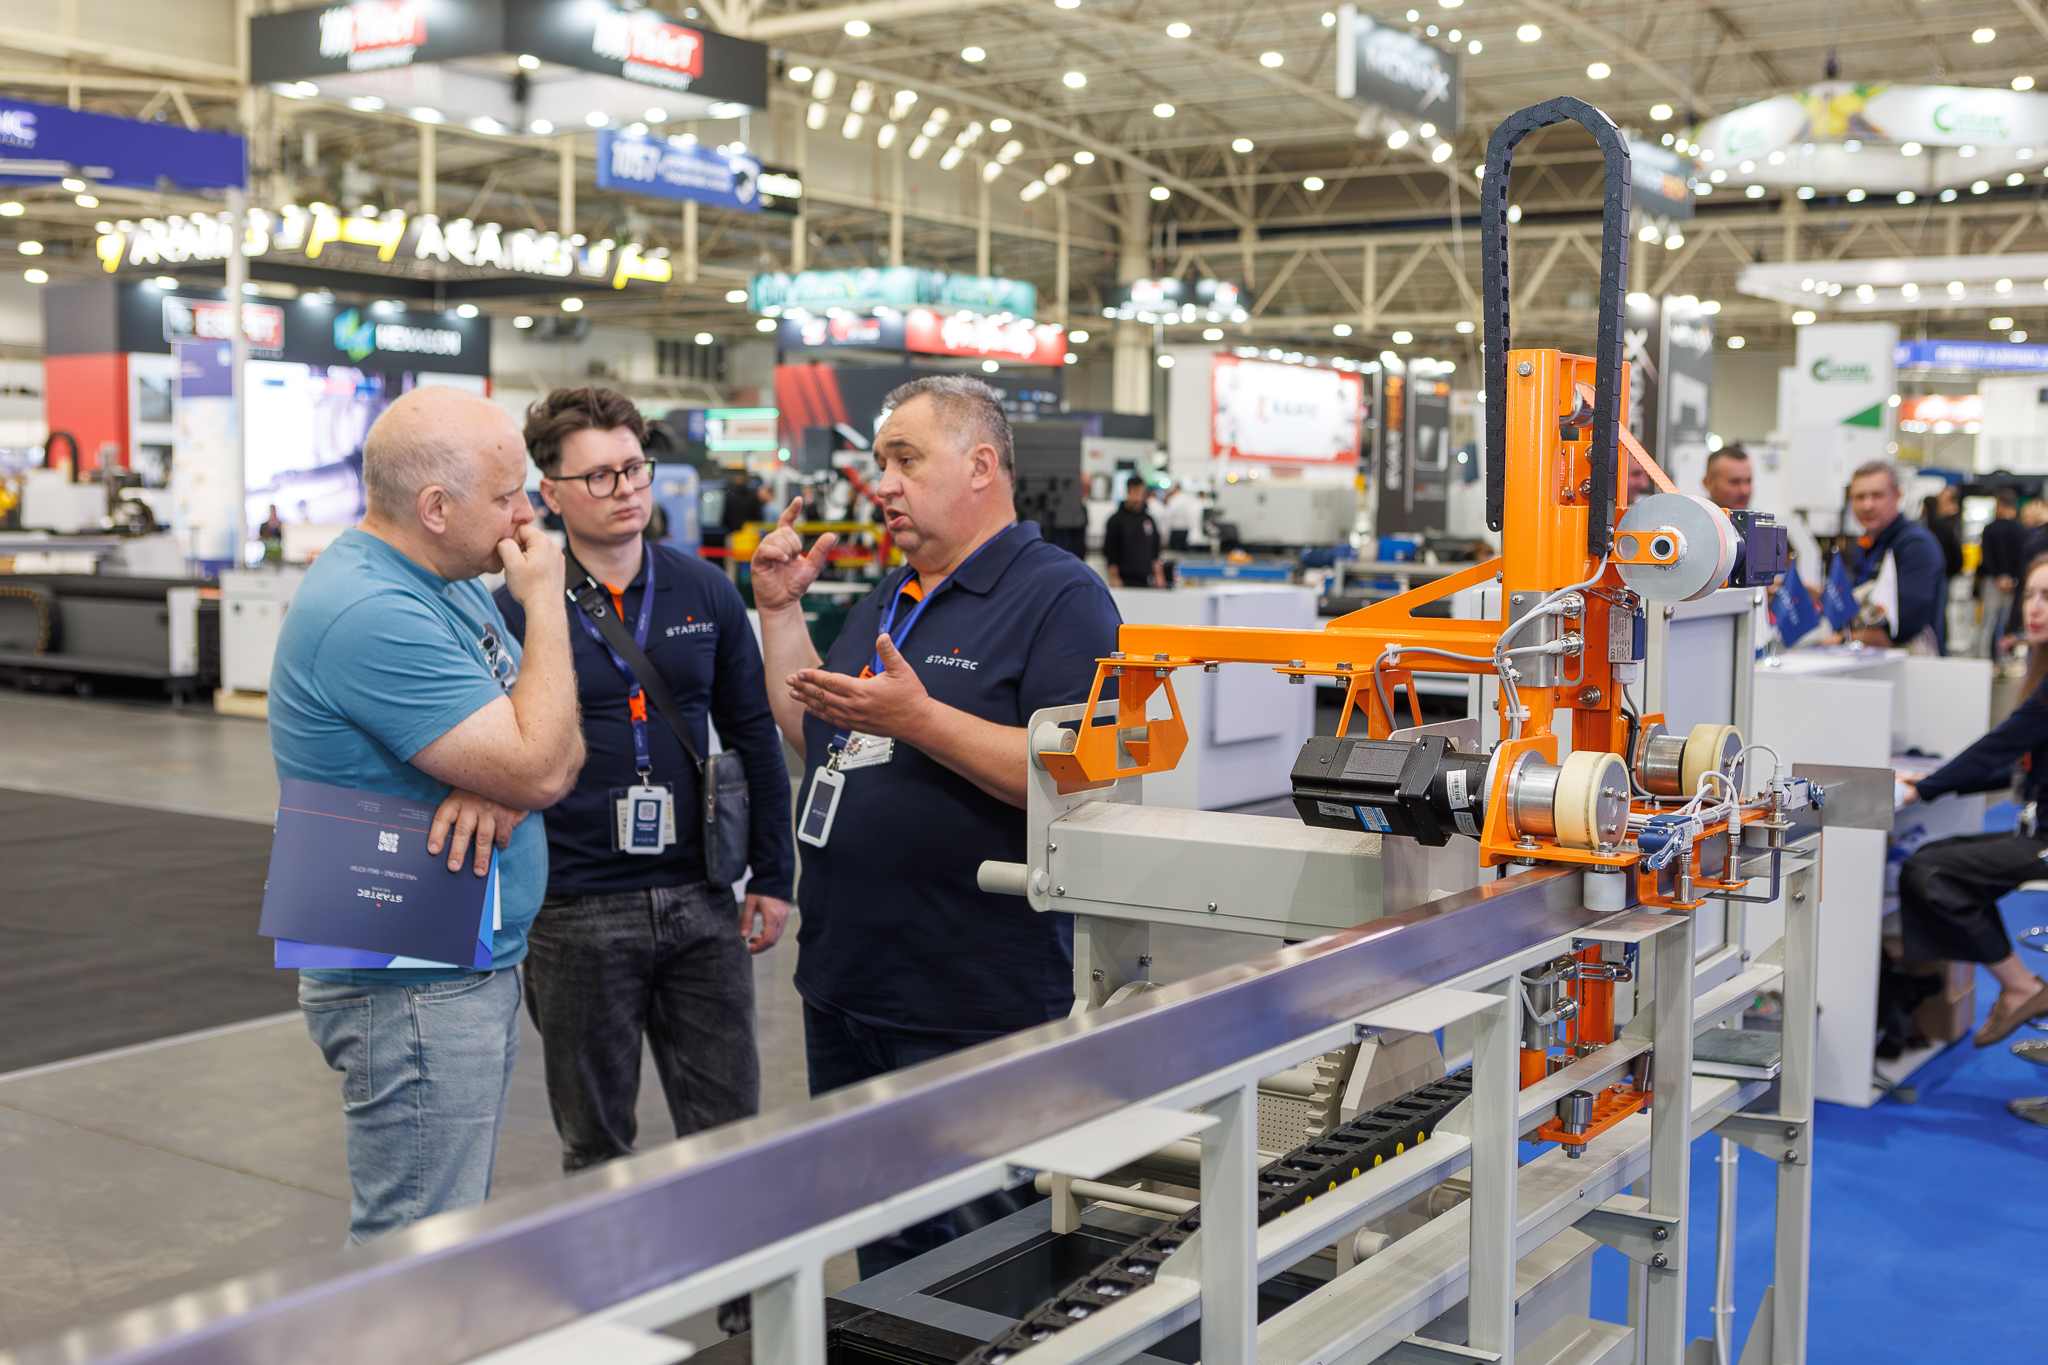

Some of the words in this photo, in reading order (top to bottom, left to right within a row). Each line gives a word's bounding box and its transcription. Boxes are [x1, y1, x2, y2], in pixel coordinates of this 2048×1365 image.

[375, 323, 462, 357] HEXAGON
[666, 622, 714, 637] STARTEC
[925, 655, 979, 670] STARTEC
[357, 888, 403, 903] STARTEC
